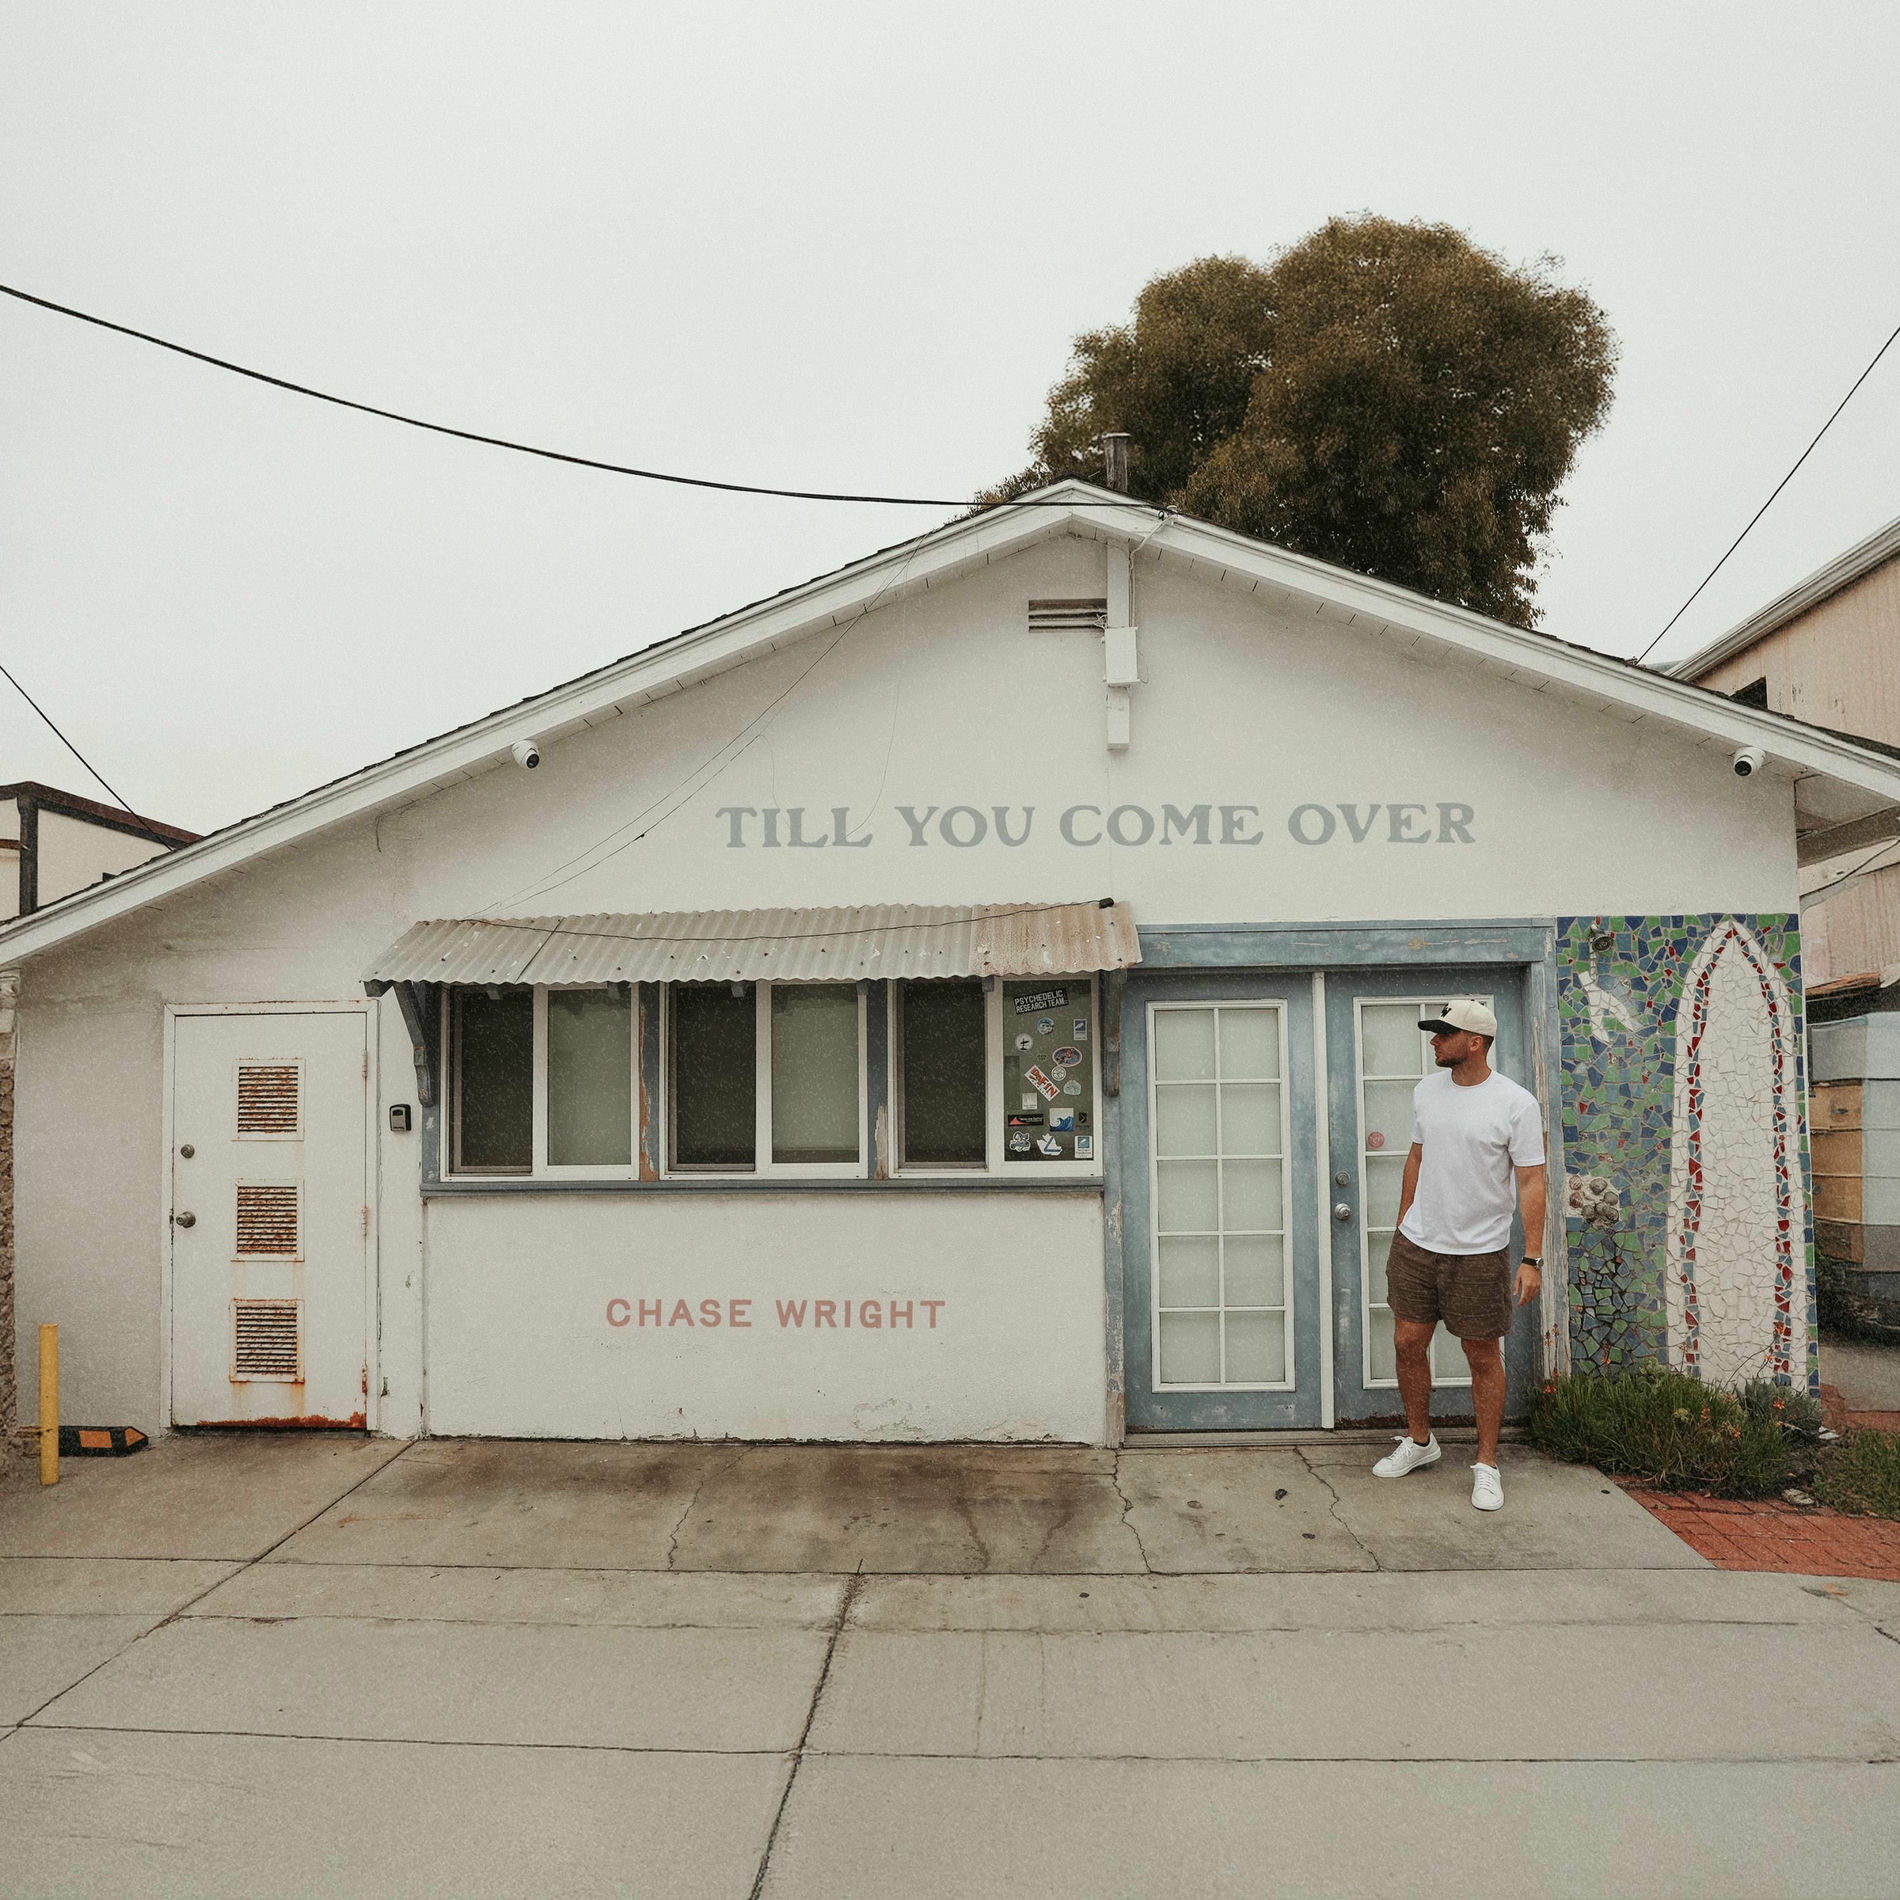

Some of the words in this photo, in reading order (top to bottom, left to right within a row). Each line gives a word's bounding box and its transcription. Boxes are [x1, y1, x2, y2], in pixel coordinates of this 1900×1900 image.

[715, 807, 873, 848] TILL
[894, 805, 1035, 847] YOU
[1059, 804, 1264, 846] COME
[1288, 803, 1476, 845] OVER
[1015, 990, 1063, 1005] PSYCHEDELIC
[1016, 1001, 1048, 1013] RESEARCH
[1048, 997, 1065, 1007] TEAM
[606, 1299, 752, 1327] CHASE
[775, 1299, 945, 1328] WRIGHT
